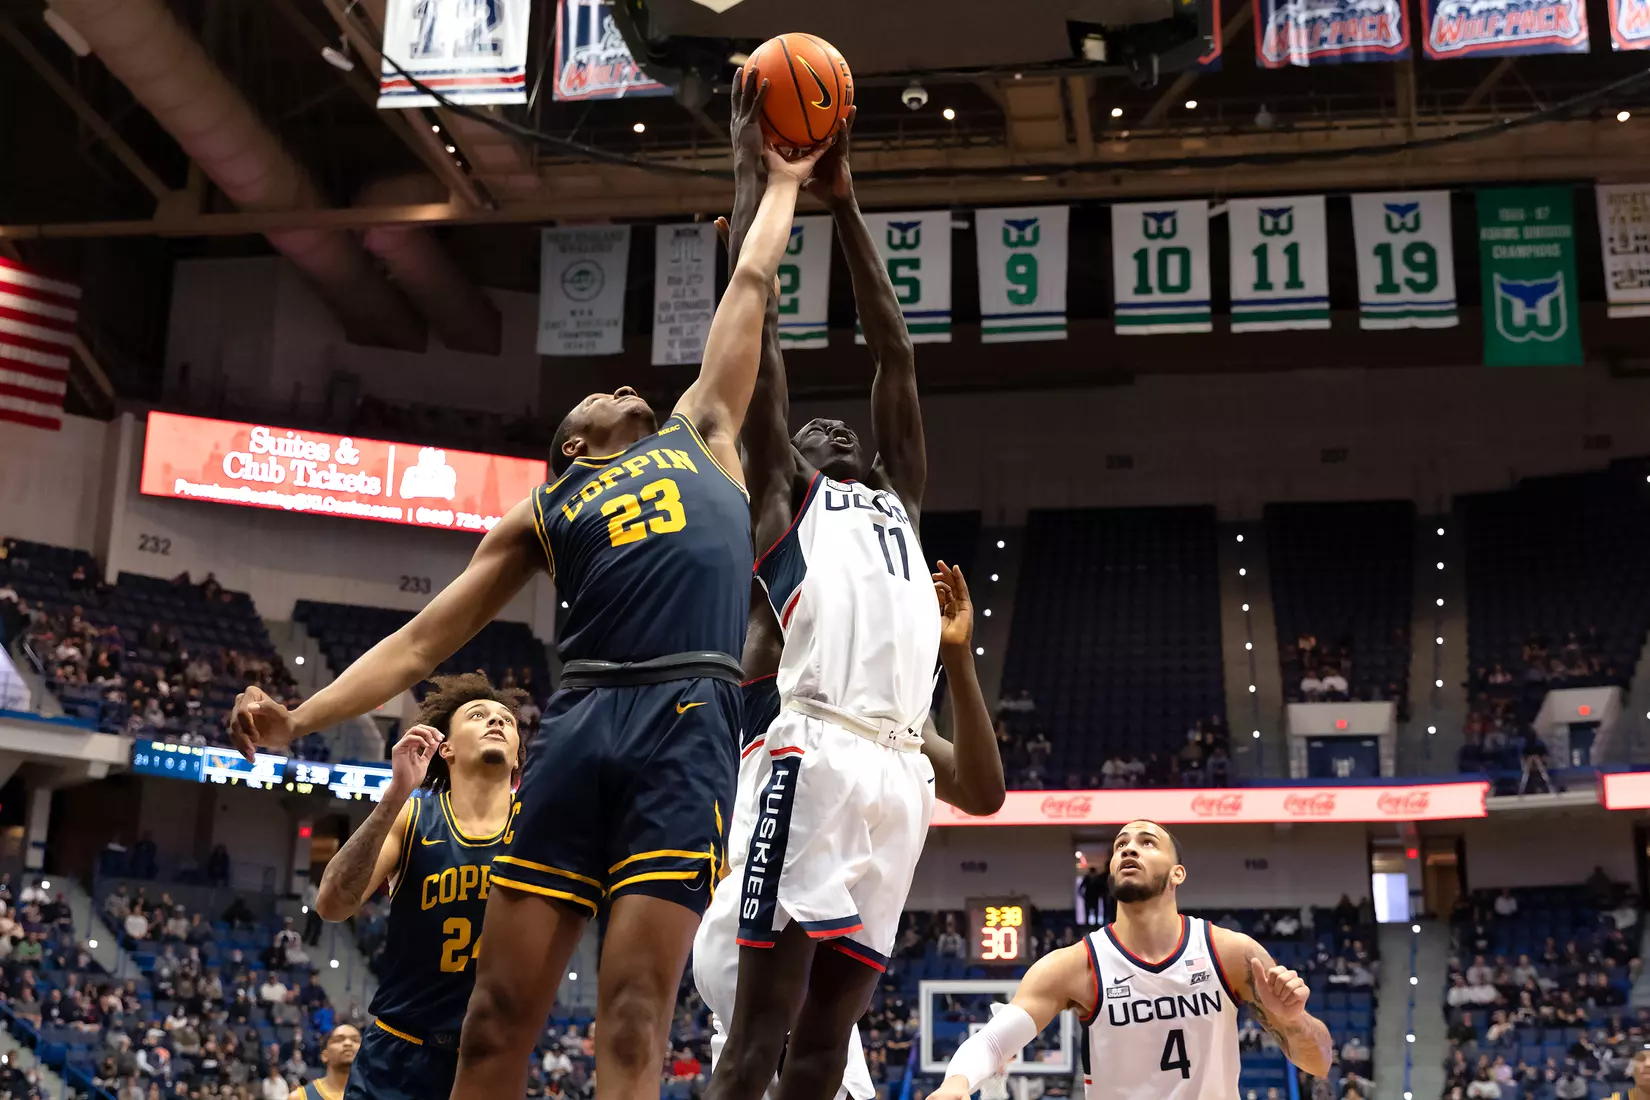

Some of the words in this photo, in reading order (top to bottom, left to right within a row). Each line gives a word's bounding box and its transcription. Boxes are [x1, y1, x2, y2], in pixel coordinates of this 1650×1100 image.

[1436, 15, 1499, 45] WOLF
[1504, 5, 1571, 36] PACK
[887, 258, 921, 304] 5
[1006, 253, 1038, 305] 9
[1133, 247, 1191, 295] 10
[1252, 242, 1305, 291] 11
[1374, 241, 1438, 294] 19
[249, 426, 331, 462] Suites
[335, 437, 360, 465] &
[657, 424, 680, 437] MEAC
[222, 451, 286, 484] Club
[290, 459, 382, 496] Tickets
[561, 448, 699, 522] COPPIN
[600, 478, 687, 548] 23
[139, 533, 171, 556] 232
[873, 523, 910, 581] 11
[400, 575, 431, 595] 233
[743, 770, 789, 920] HUSKIES
[440, 917, 481, 973] 2
[981, 927, 1018, 960] 30
[1108, 991, 1222, 1027] UCONN
[1160, 1029, 1191, 1079] 4
